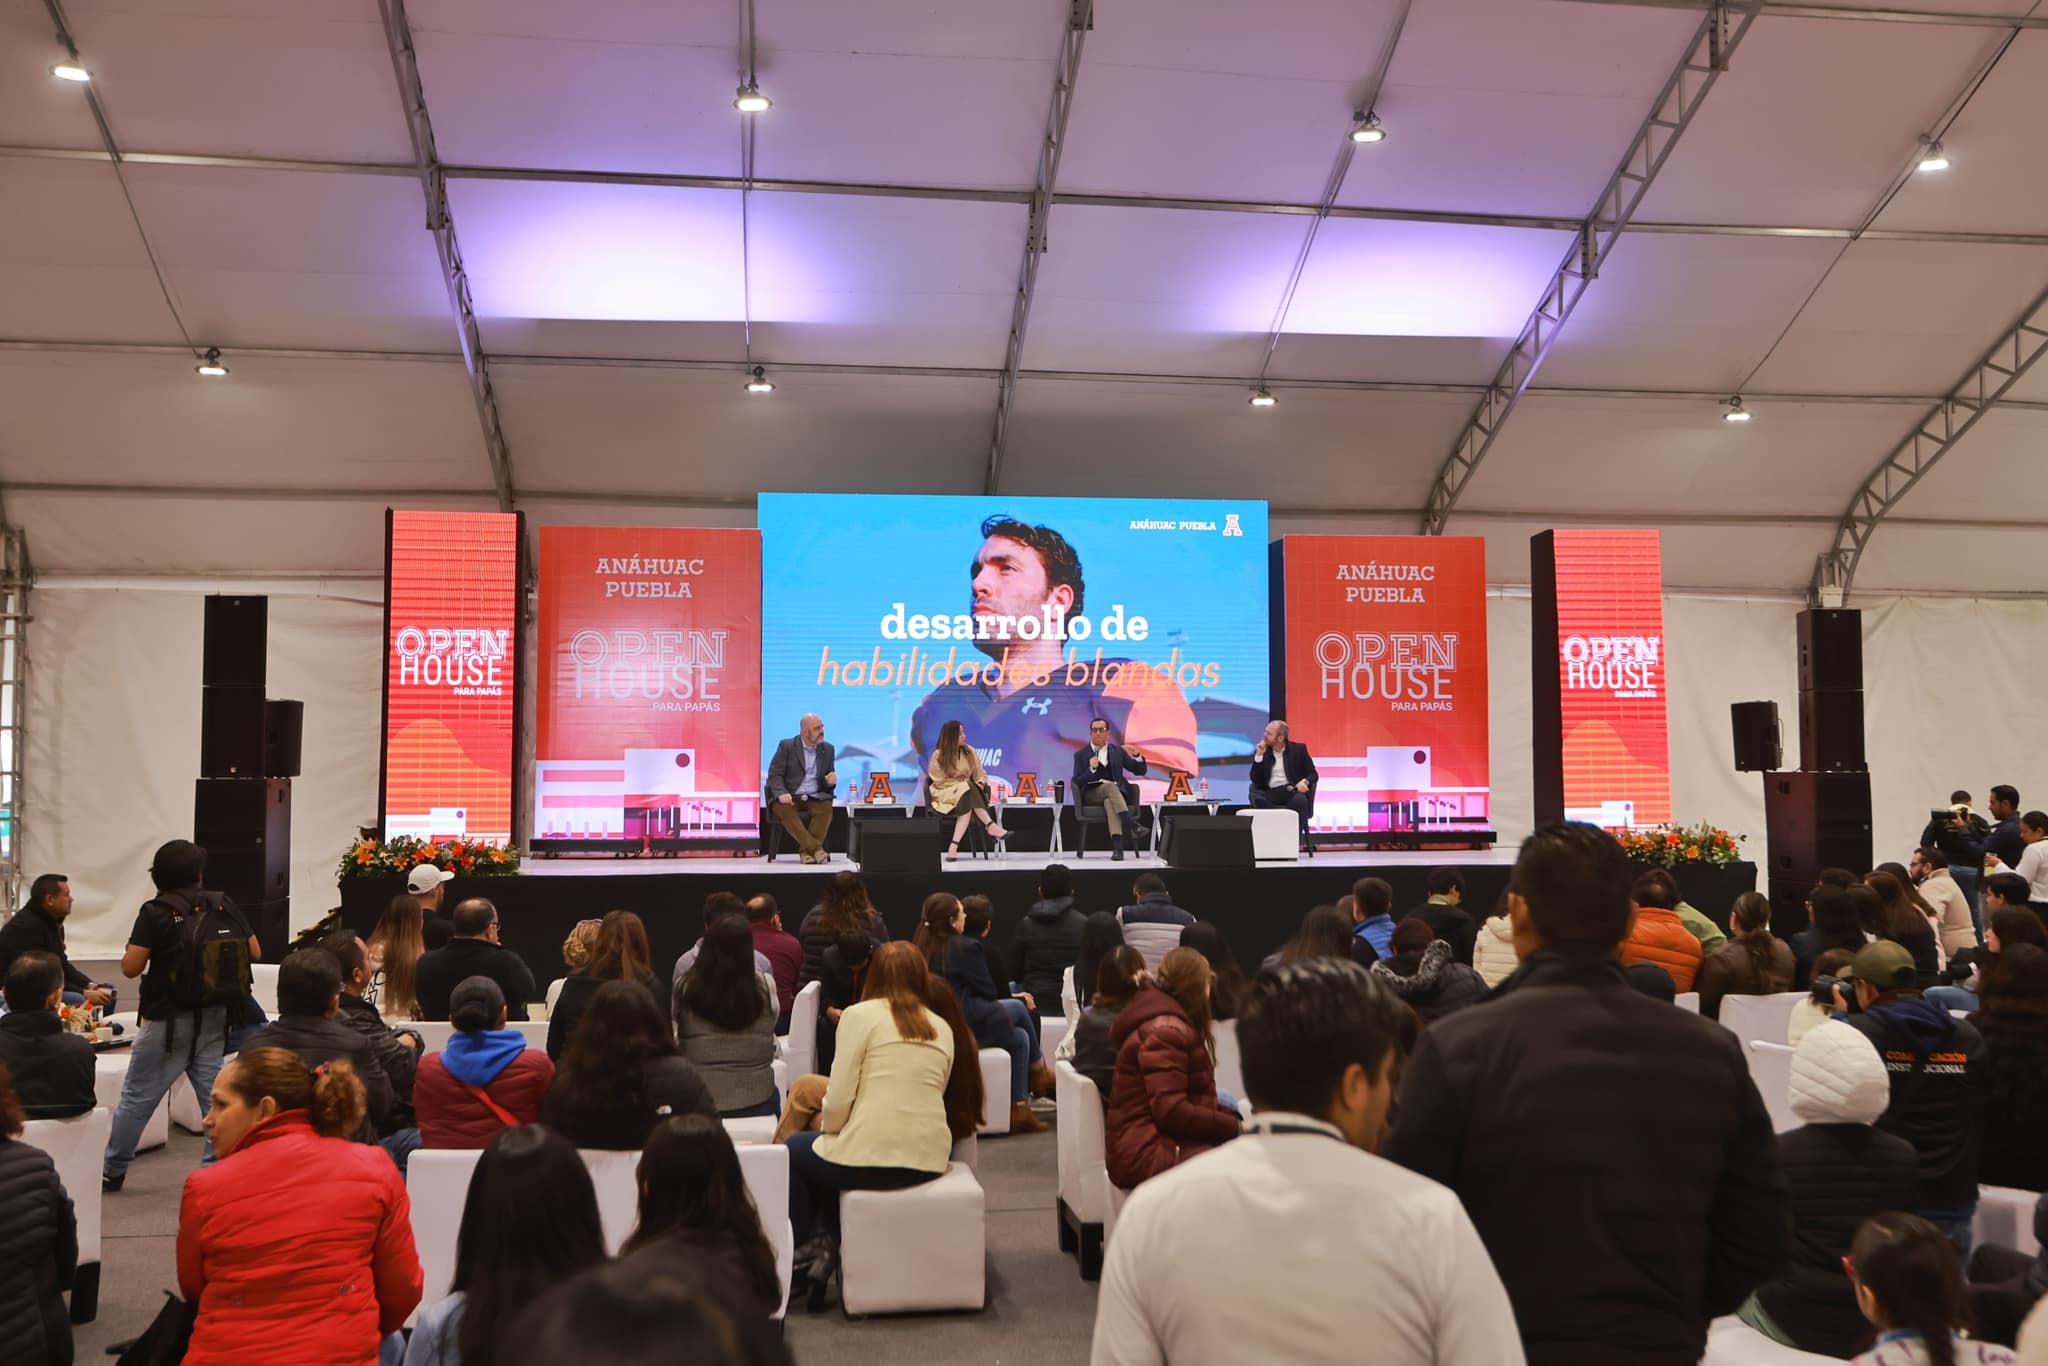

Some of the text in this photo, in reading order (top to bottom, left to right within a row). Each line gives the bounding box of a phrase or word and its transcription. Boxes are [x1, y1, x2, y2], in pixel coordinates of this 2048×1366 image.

[1129, 519, 1217, 531] ANÁHUAC PUEBLA
[595, 553, 704, 575] ANÁHUAC
[1336, 560, 1435, 581] ANÁHUAC
[605, 581, 693, 598] PUEBLA
[1345, 587, 1425, 603] PUEBLA
[880, 603, 1149, 641] desarrollo de
[395, 626, 509, 660] OPEN
[569, 628, 728, 670] OPEN
[1313, 632, 1459, 672] OPEN
[1562, 635, 1660, 665] OPEN
[400, 655, 503, 687] HOUSE
[576, 661, 721, 701] HOUSE
[816, 646, 1222, 688] habilidades blandas
[1568, 660, 1657, 689] HOUSE
[454, 685, 503, 697] PARA PAPÁS
[1321, 664, 1453, 700] HOUSE
[653, 701, 721, 713] PARA PAPÁS
[1391, 700, 1453, 712] PARA PAPÁS
